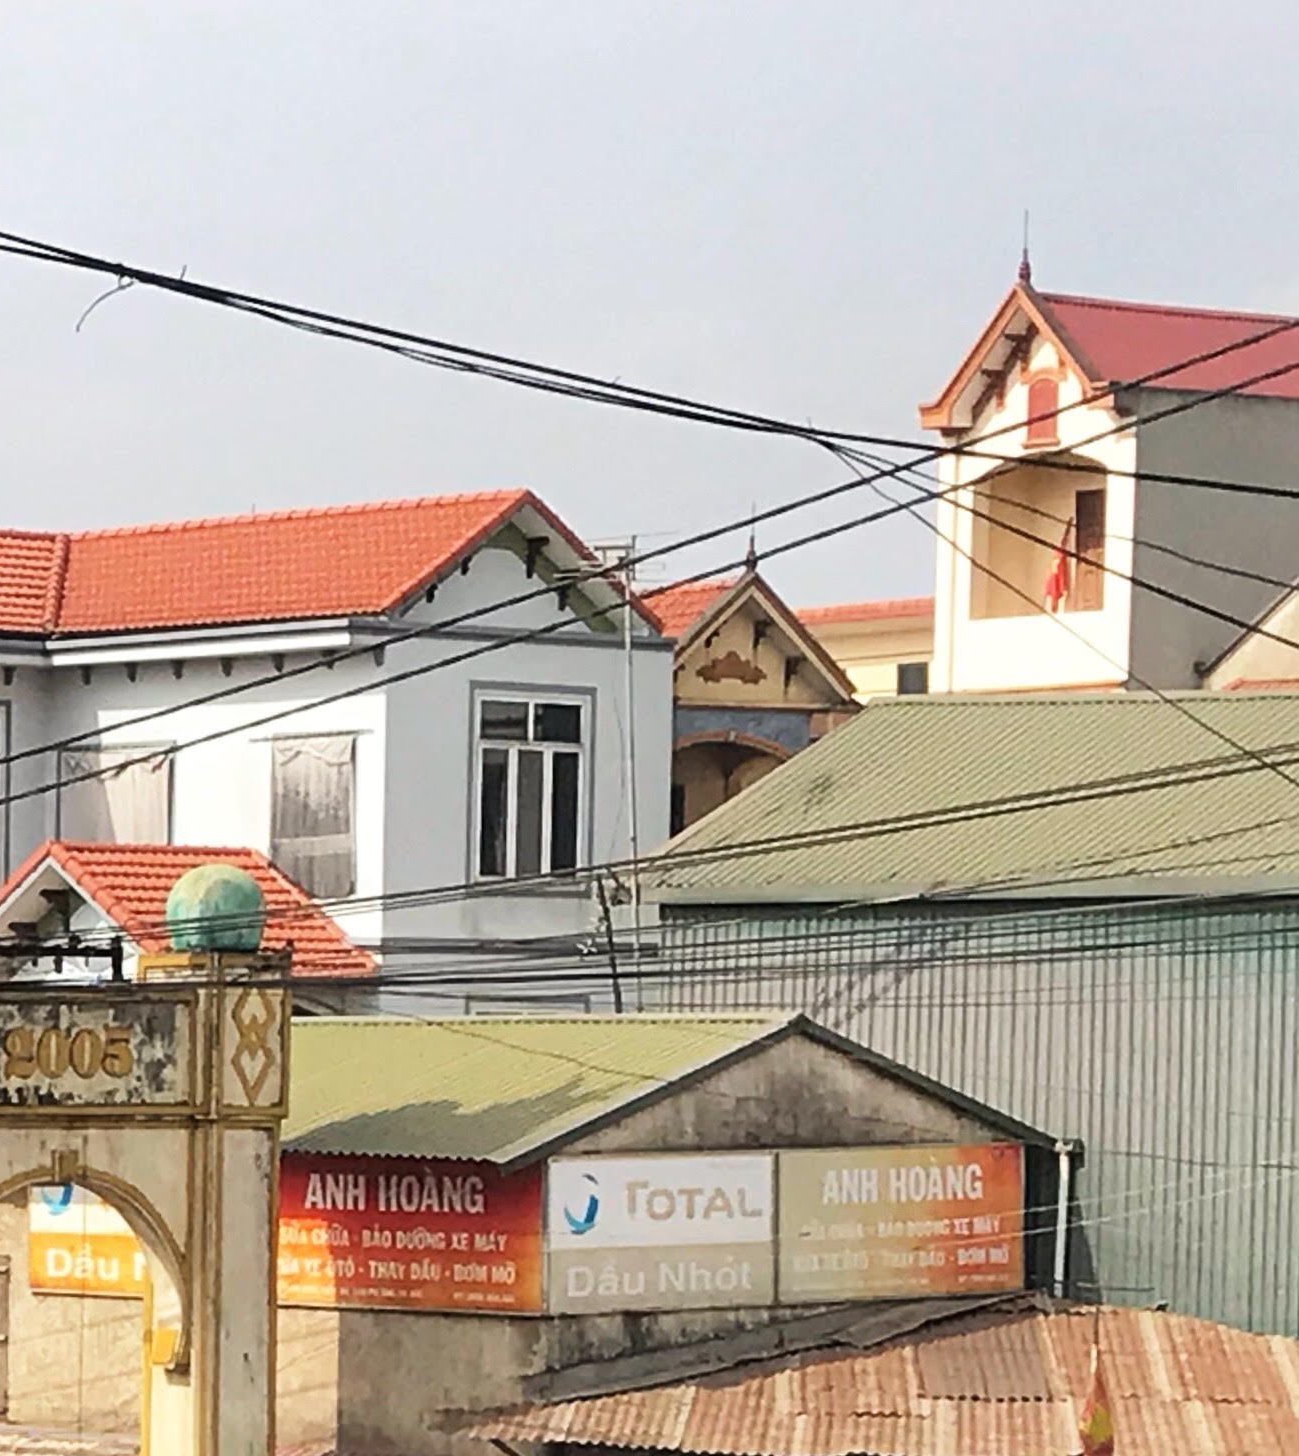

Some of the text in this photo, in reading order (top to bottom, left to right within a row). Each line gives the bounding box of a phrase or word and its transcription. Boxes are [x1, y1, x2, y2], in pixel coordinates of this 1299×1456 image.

[5, 1024, 134, 1081] 2005
[304, 1166, 485, 1214] ANH HOÀNG
[625, 1178, 764, 1222] TOTAL
[822, 1155, 984, 1205] ANH HOÀNG
